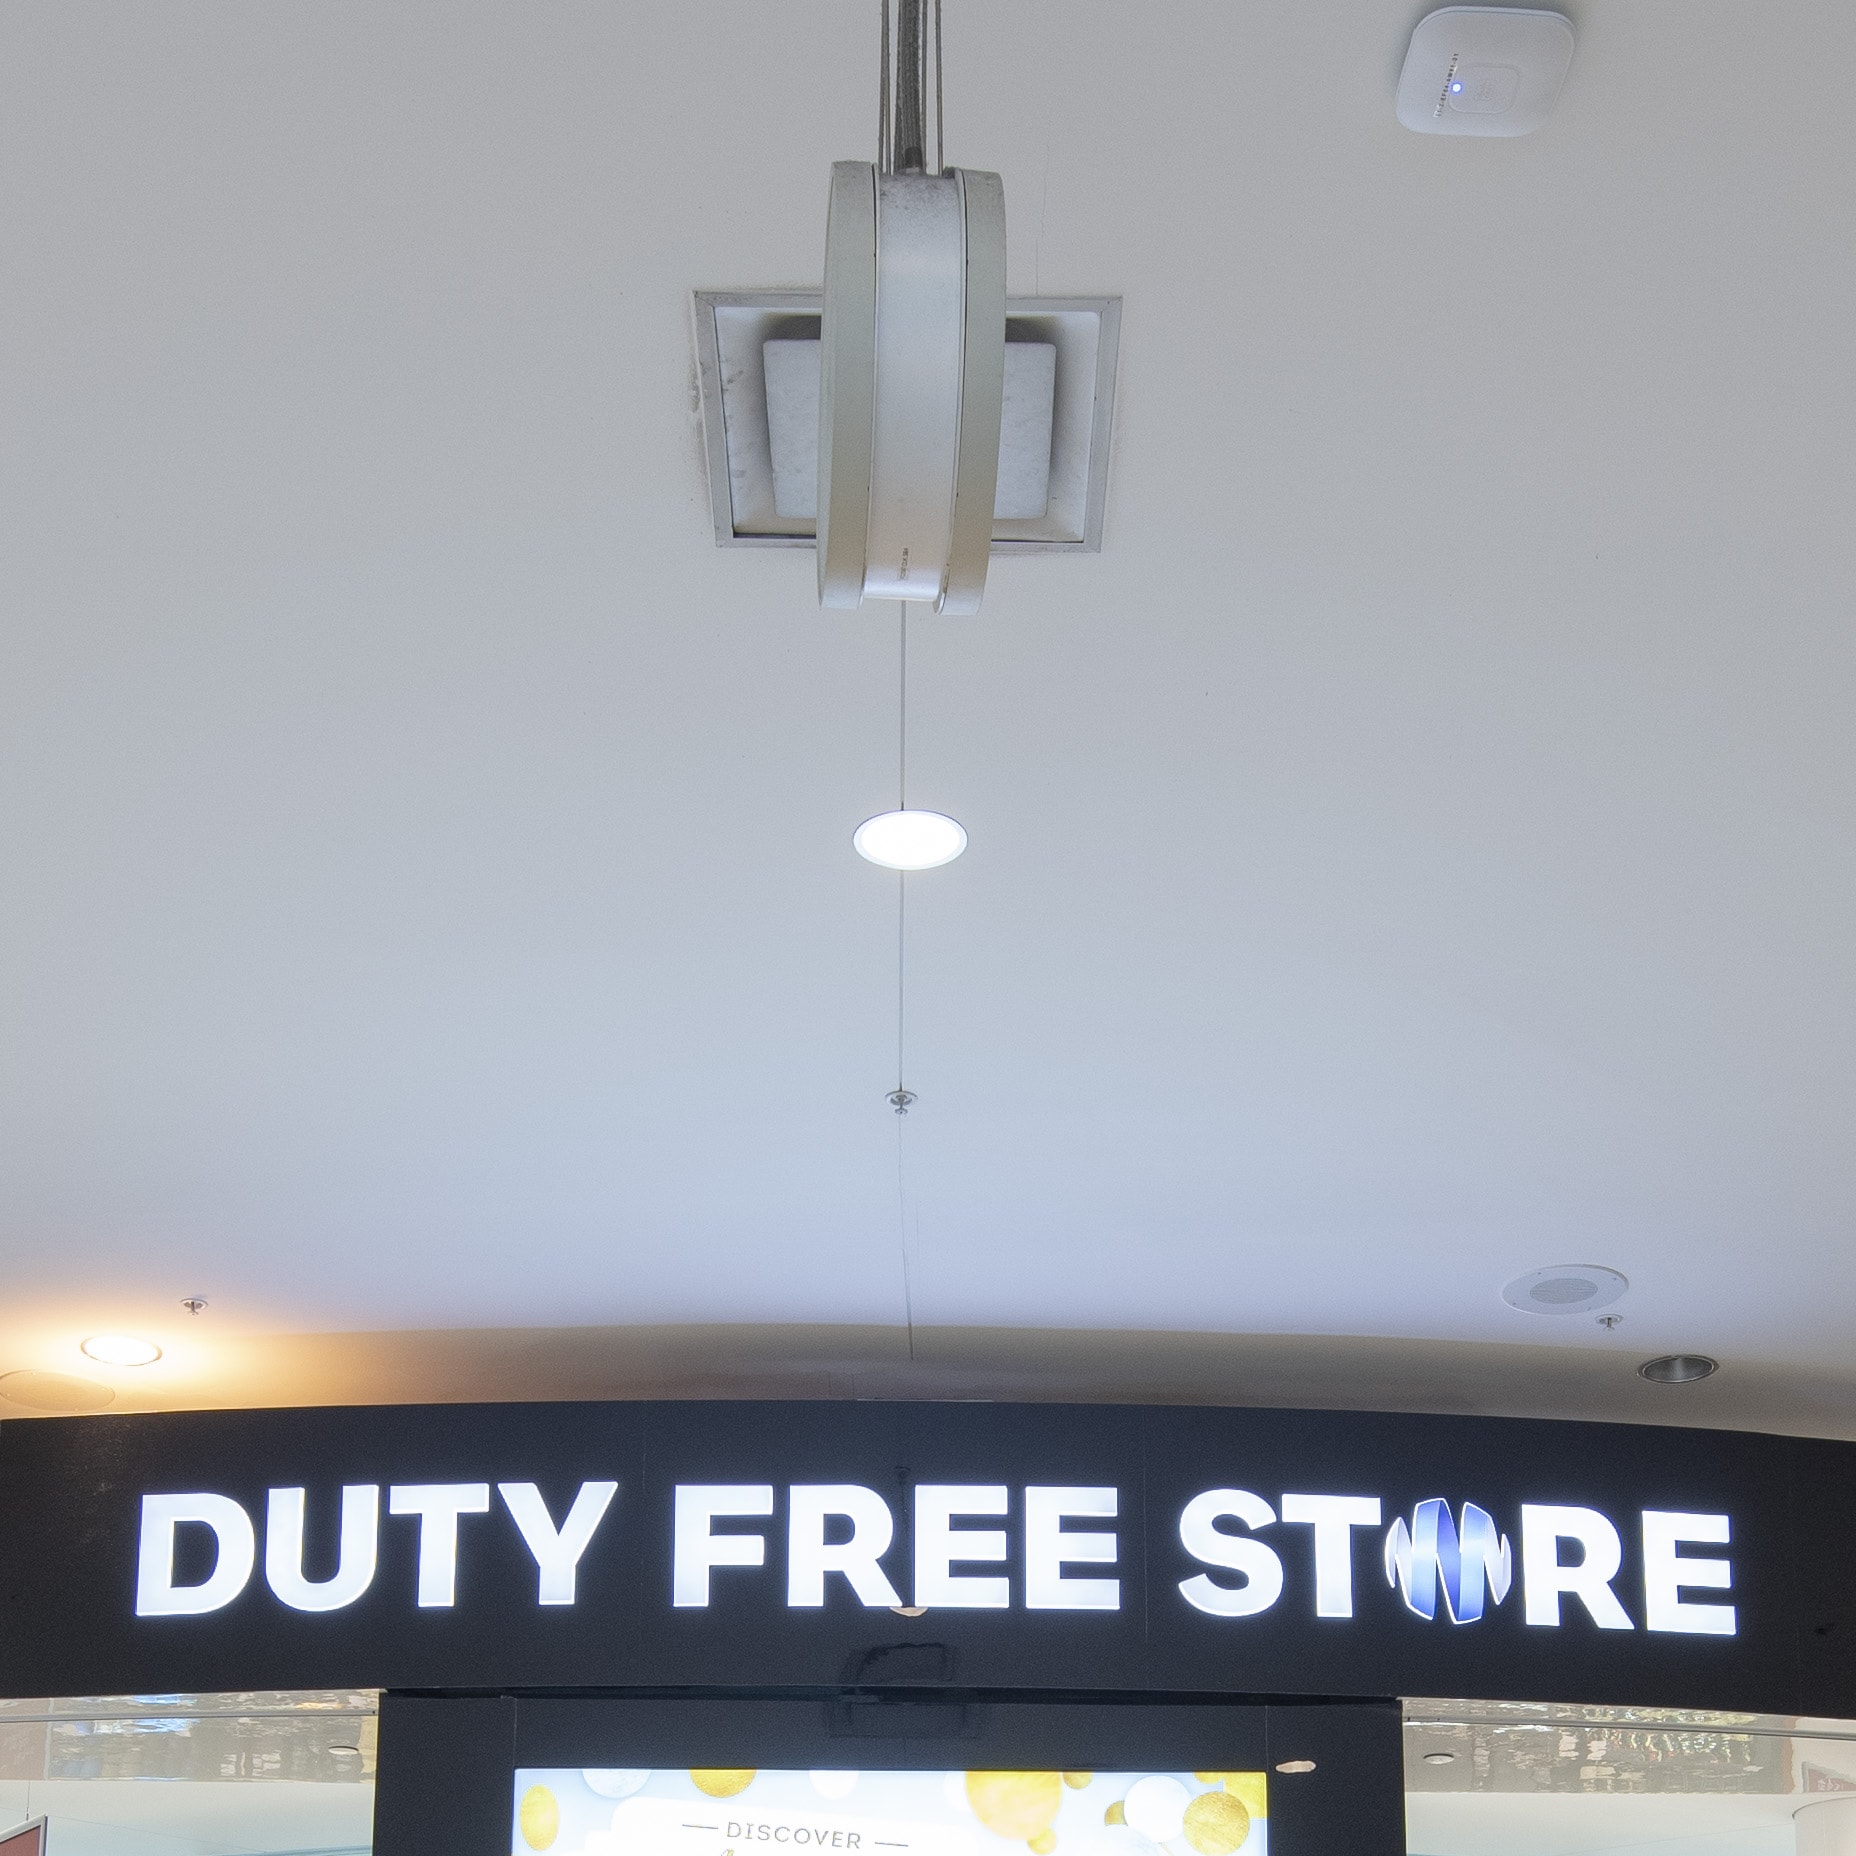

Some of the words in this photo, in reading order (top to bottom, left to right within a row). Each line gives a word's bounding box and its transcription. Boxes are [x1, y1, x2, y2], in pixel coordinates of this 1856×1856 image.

[134, 1481, 619, 1617] DUTY
[673, 1484, 1121, 1610] FREE
[726, 1820, 862, 1849] DISCOVER
